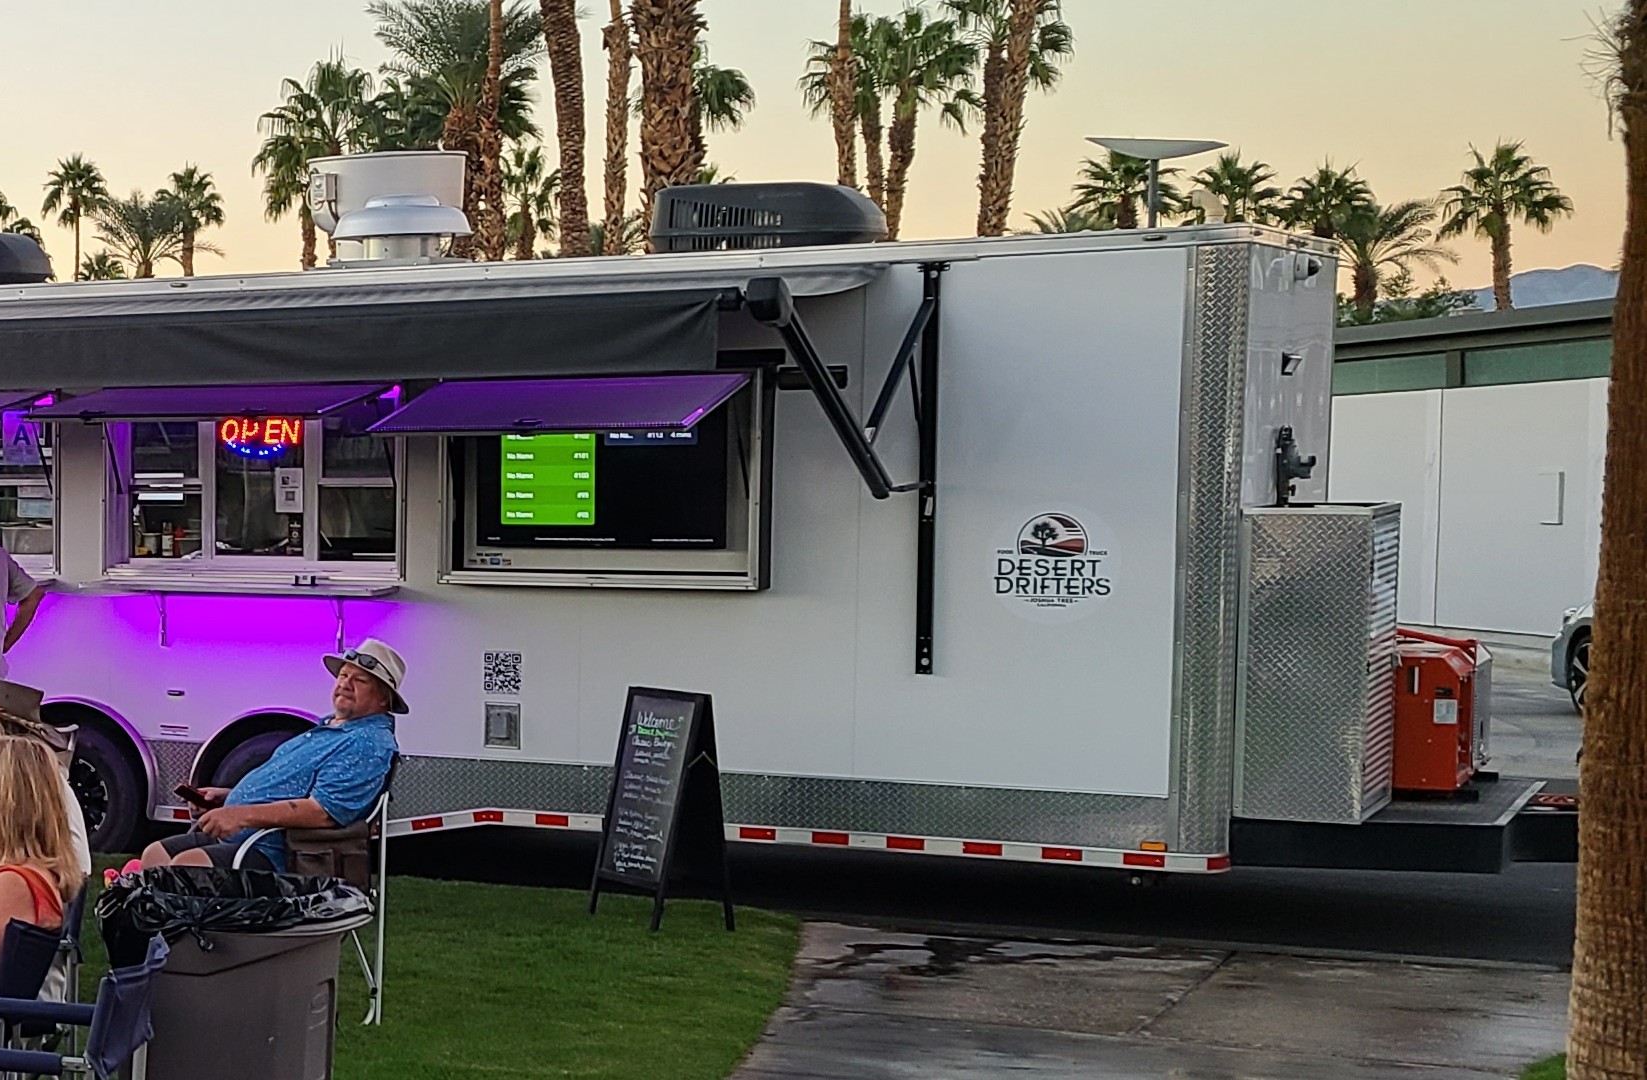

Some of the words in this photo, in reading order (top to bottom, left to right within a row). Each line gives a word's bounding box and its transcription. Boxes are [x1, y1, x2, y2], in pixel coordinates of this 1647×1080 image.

[13, 424, 31, 446] A
[220, 418, 301, 444] OPEN
[997, 558, 1102, 577] DESERT
[993, 576, 1111, 596] DRIFTERS
